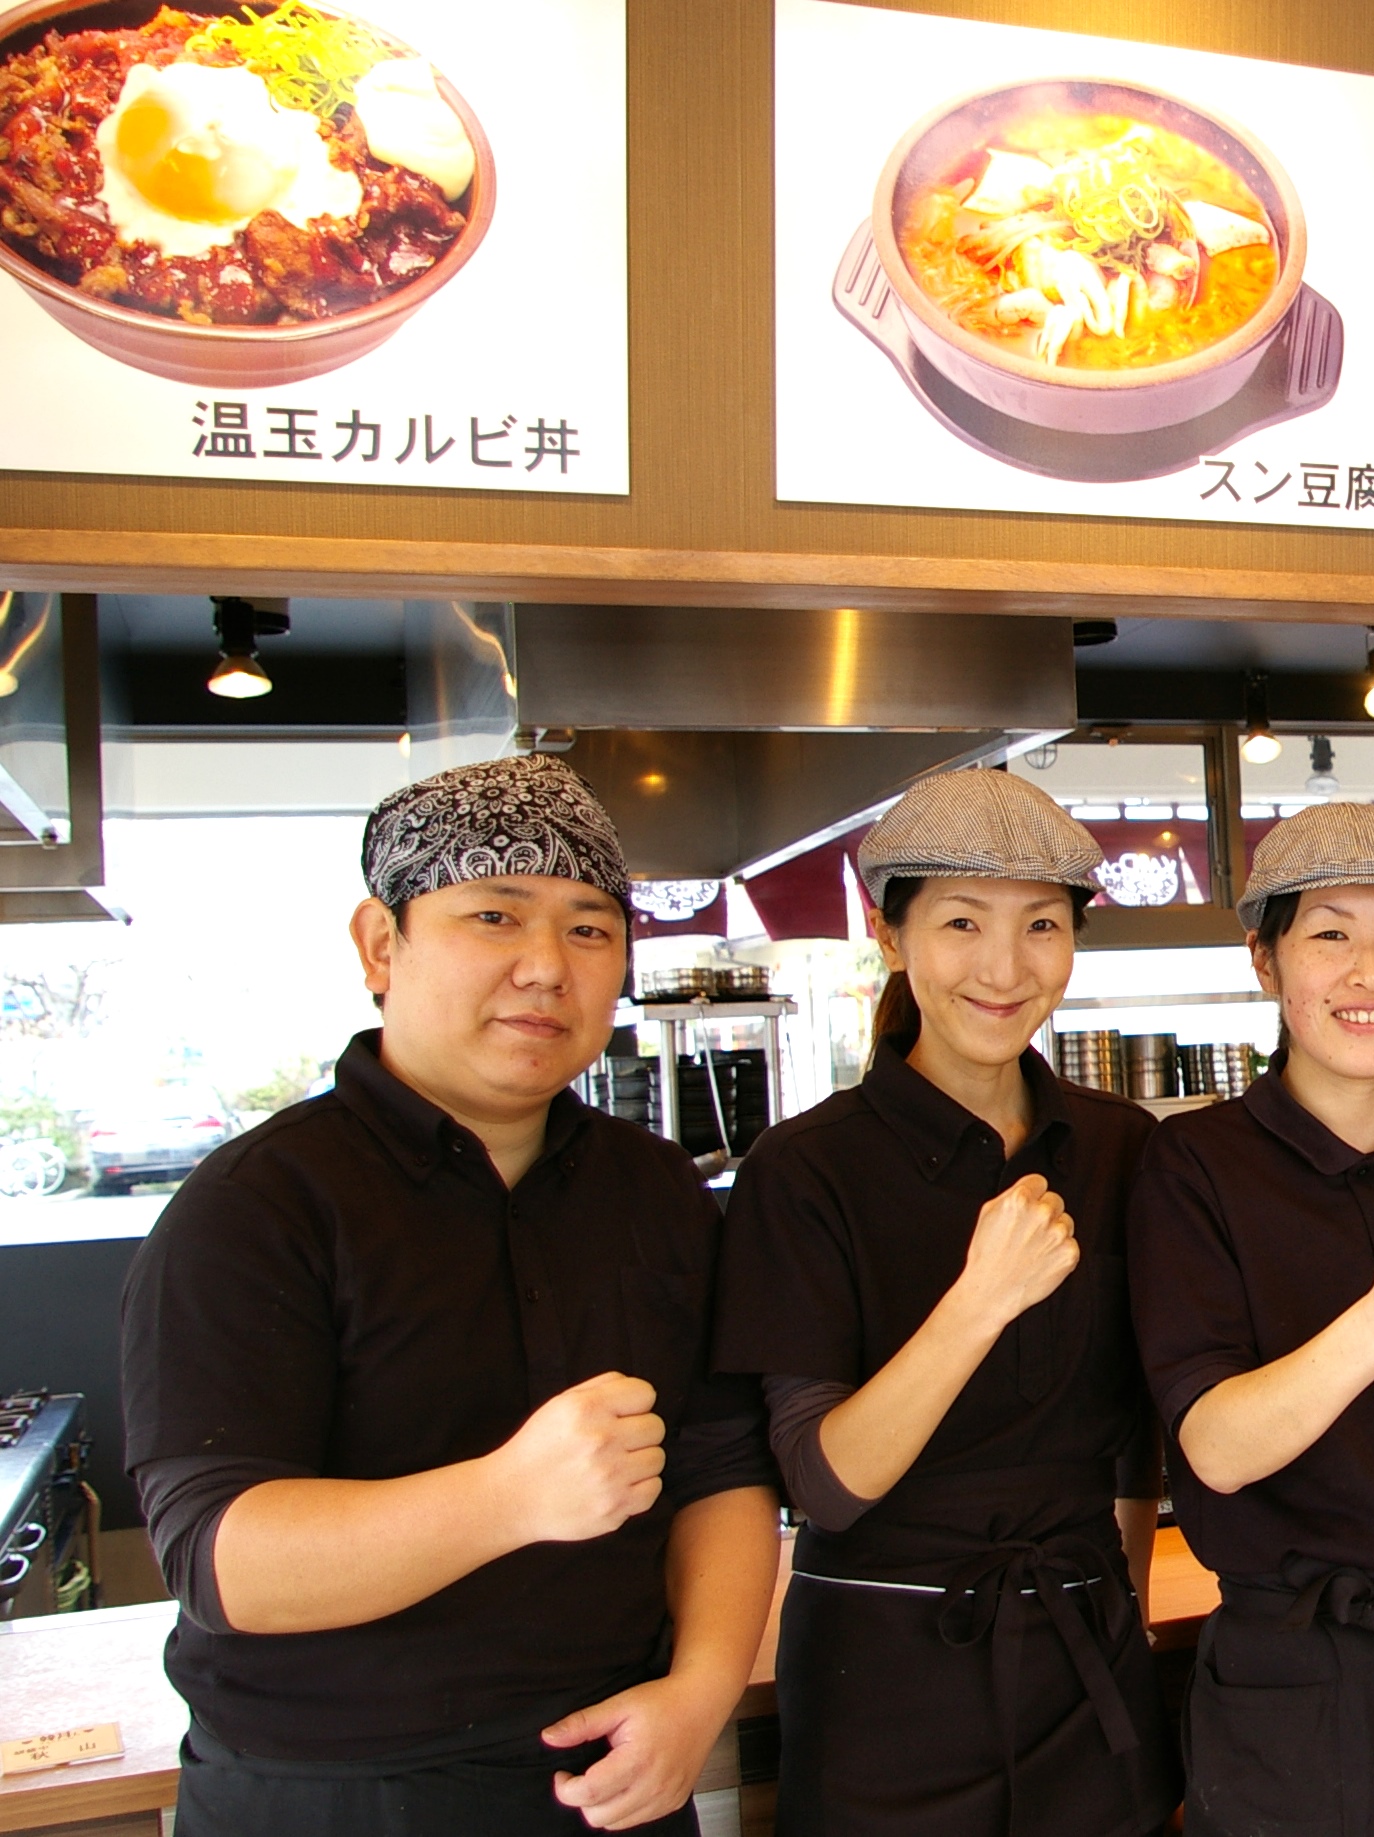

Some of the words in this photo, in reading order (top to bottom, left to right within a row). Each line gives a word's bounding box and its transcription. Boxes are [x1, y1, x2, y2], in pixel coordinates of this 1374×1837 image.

[191, 400, 581, 475] 温玉カルビ丼
